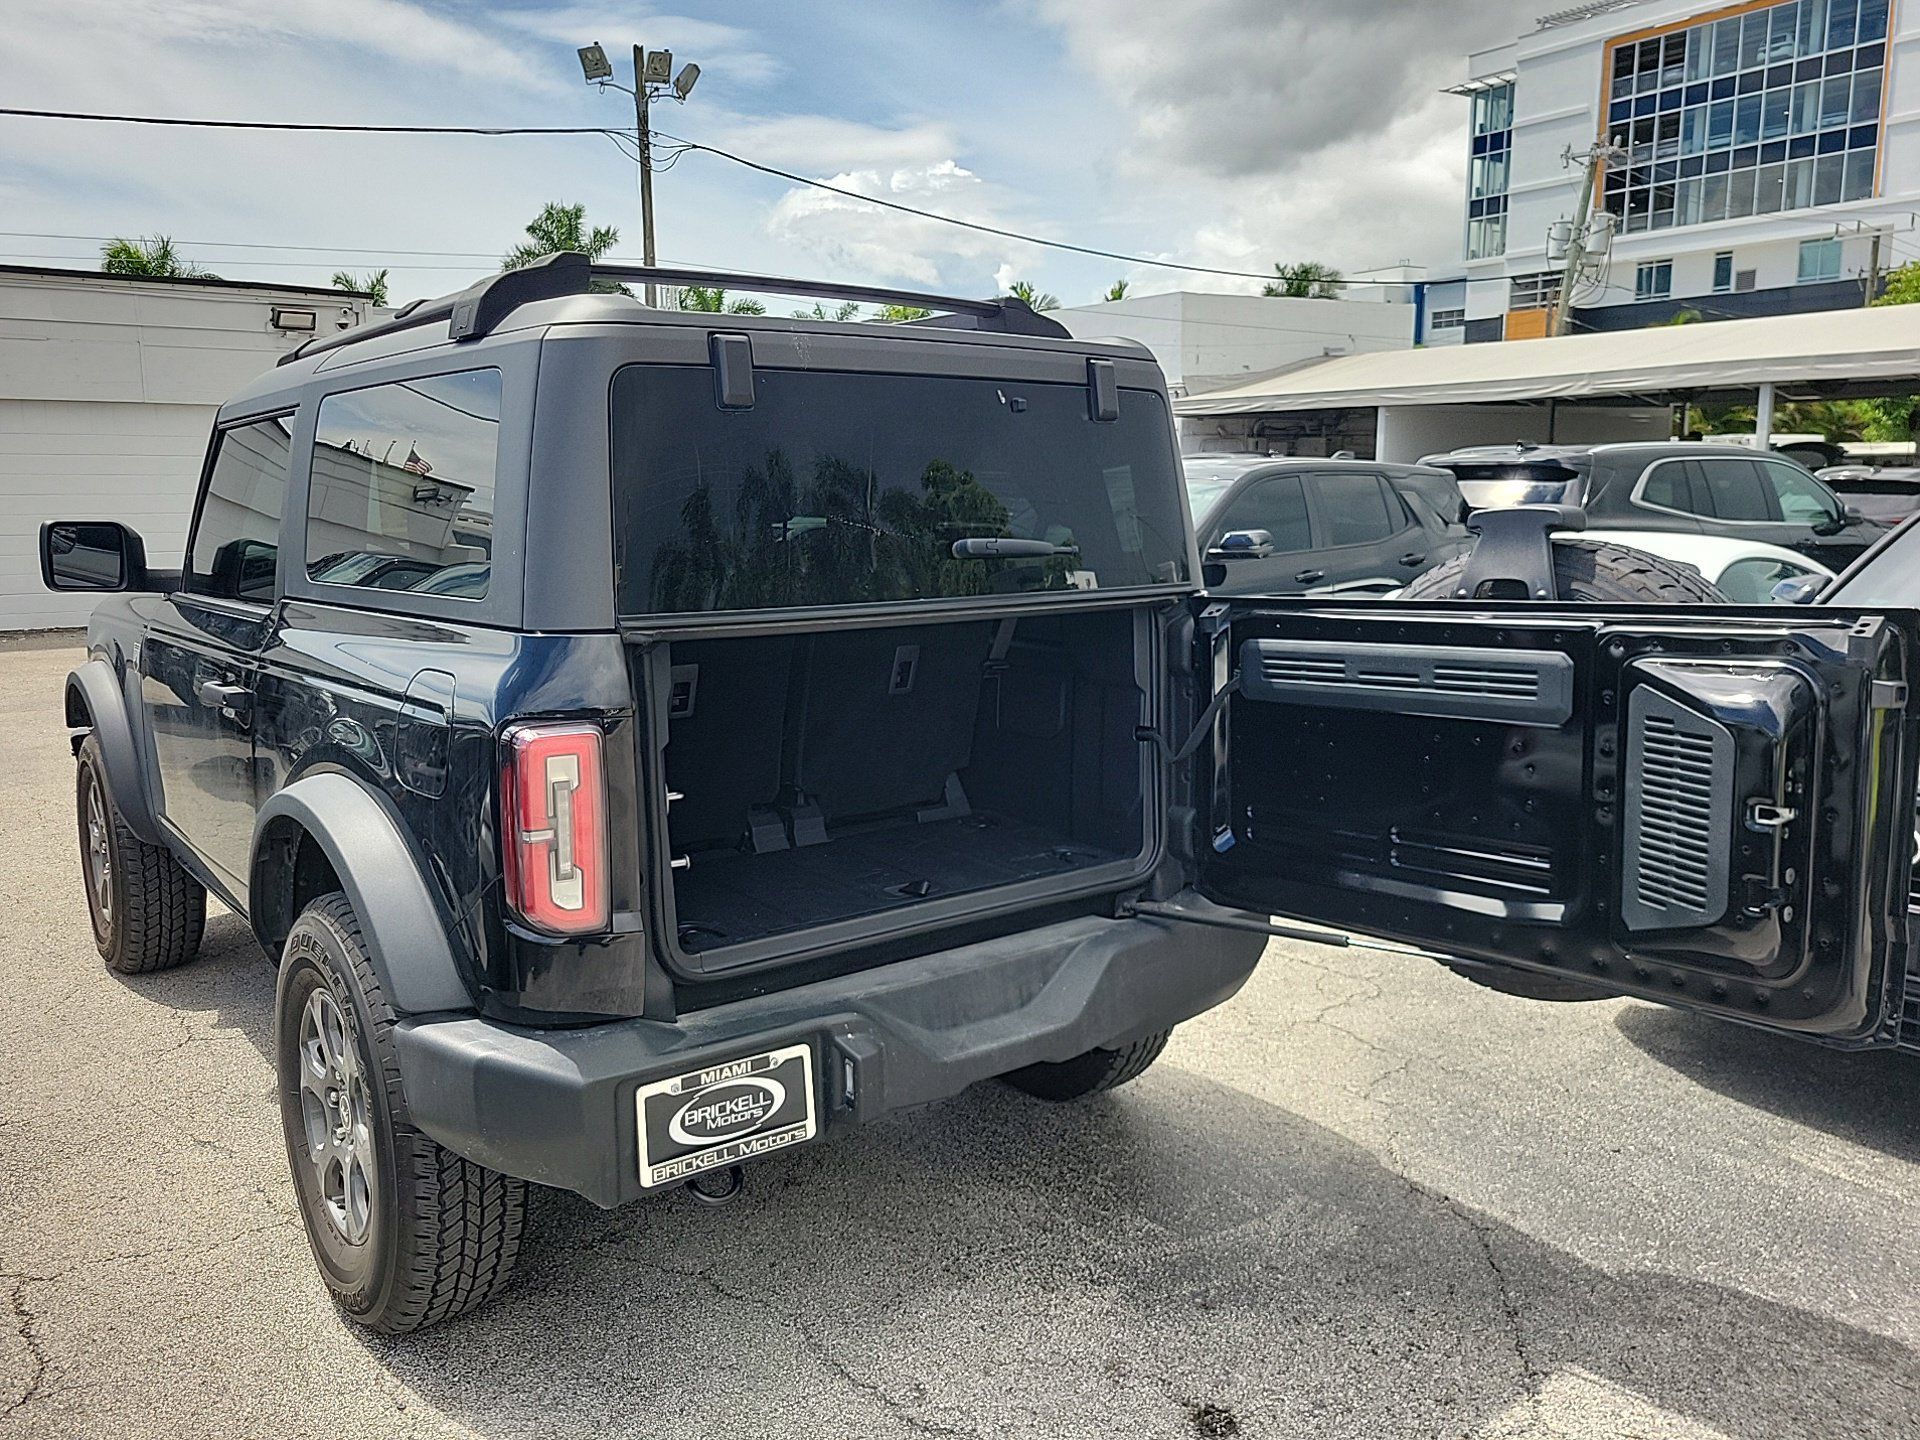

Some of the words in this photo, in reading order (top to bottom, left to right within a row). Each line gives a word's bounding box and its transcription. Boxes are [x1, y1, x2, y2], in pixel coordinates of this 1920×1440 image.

[291, 930, 359, 1042] DUELER
[700, 1061, 752, 1085] MIAMI
[684, 1092, 771, 1127] BRICKELL
[706, 1107, 763, 1130] Motors
[653, 1149, 735, 1182] BRICKELL
[739, 1126, 806, 1156] Motors
